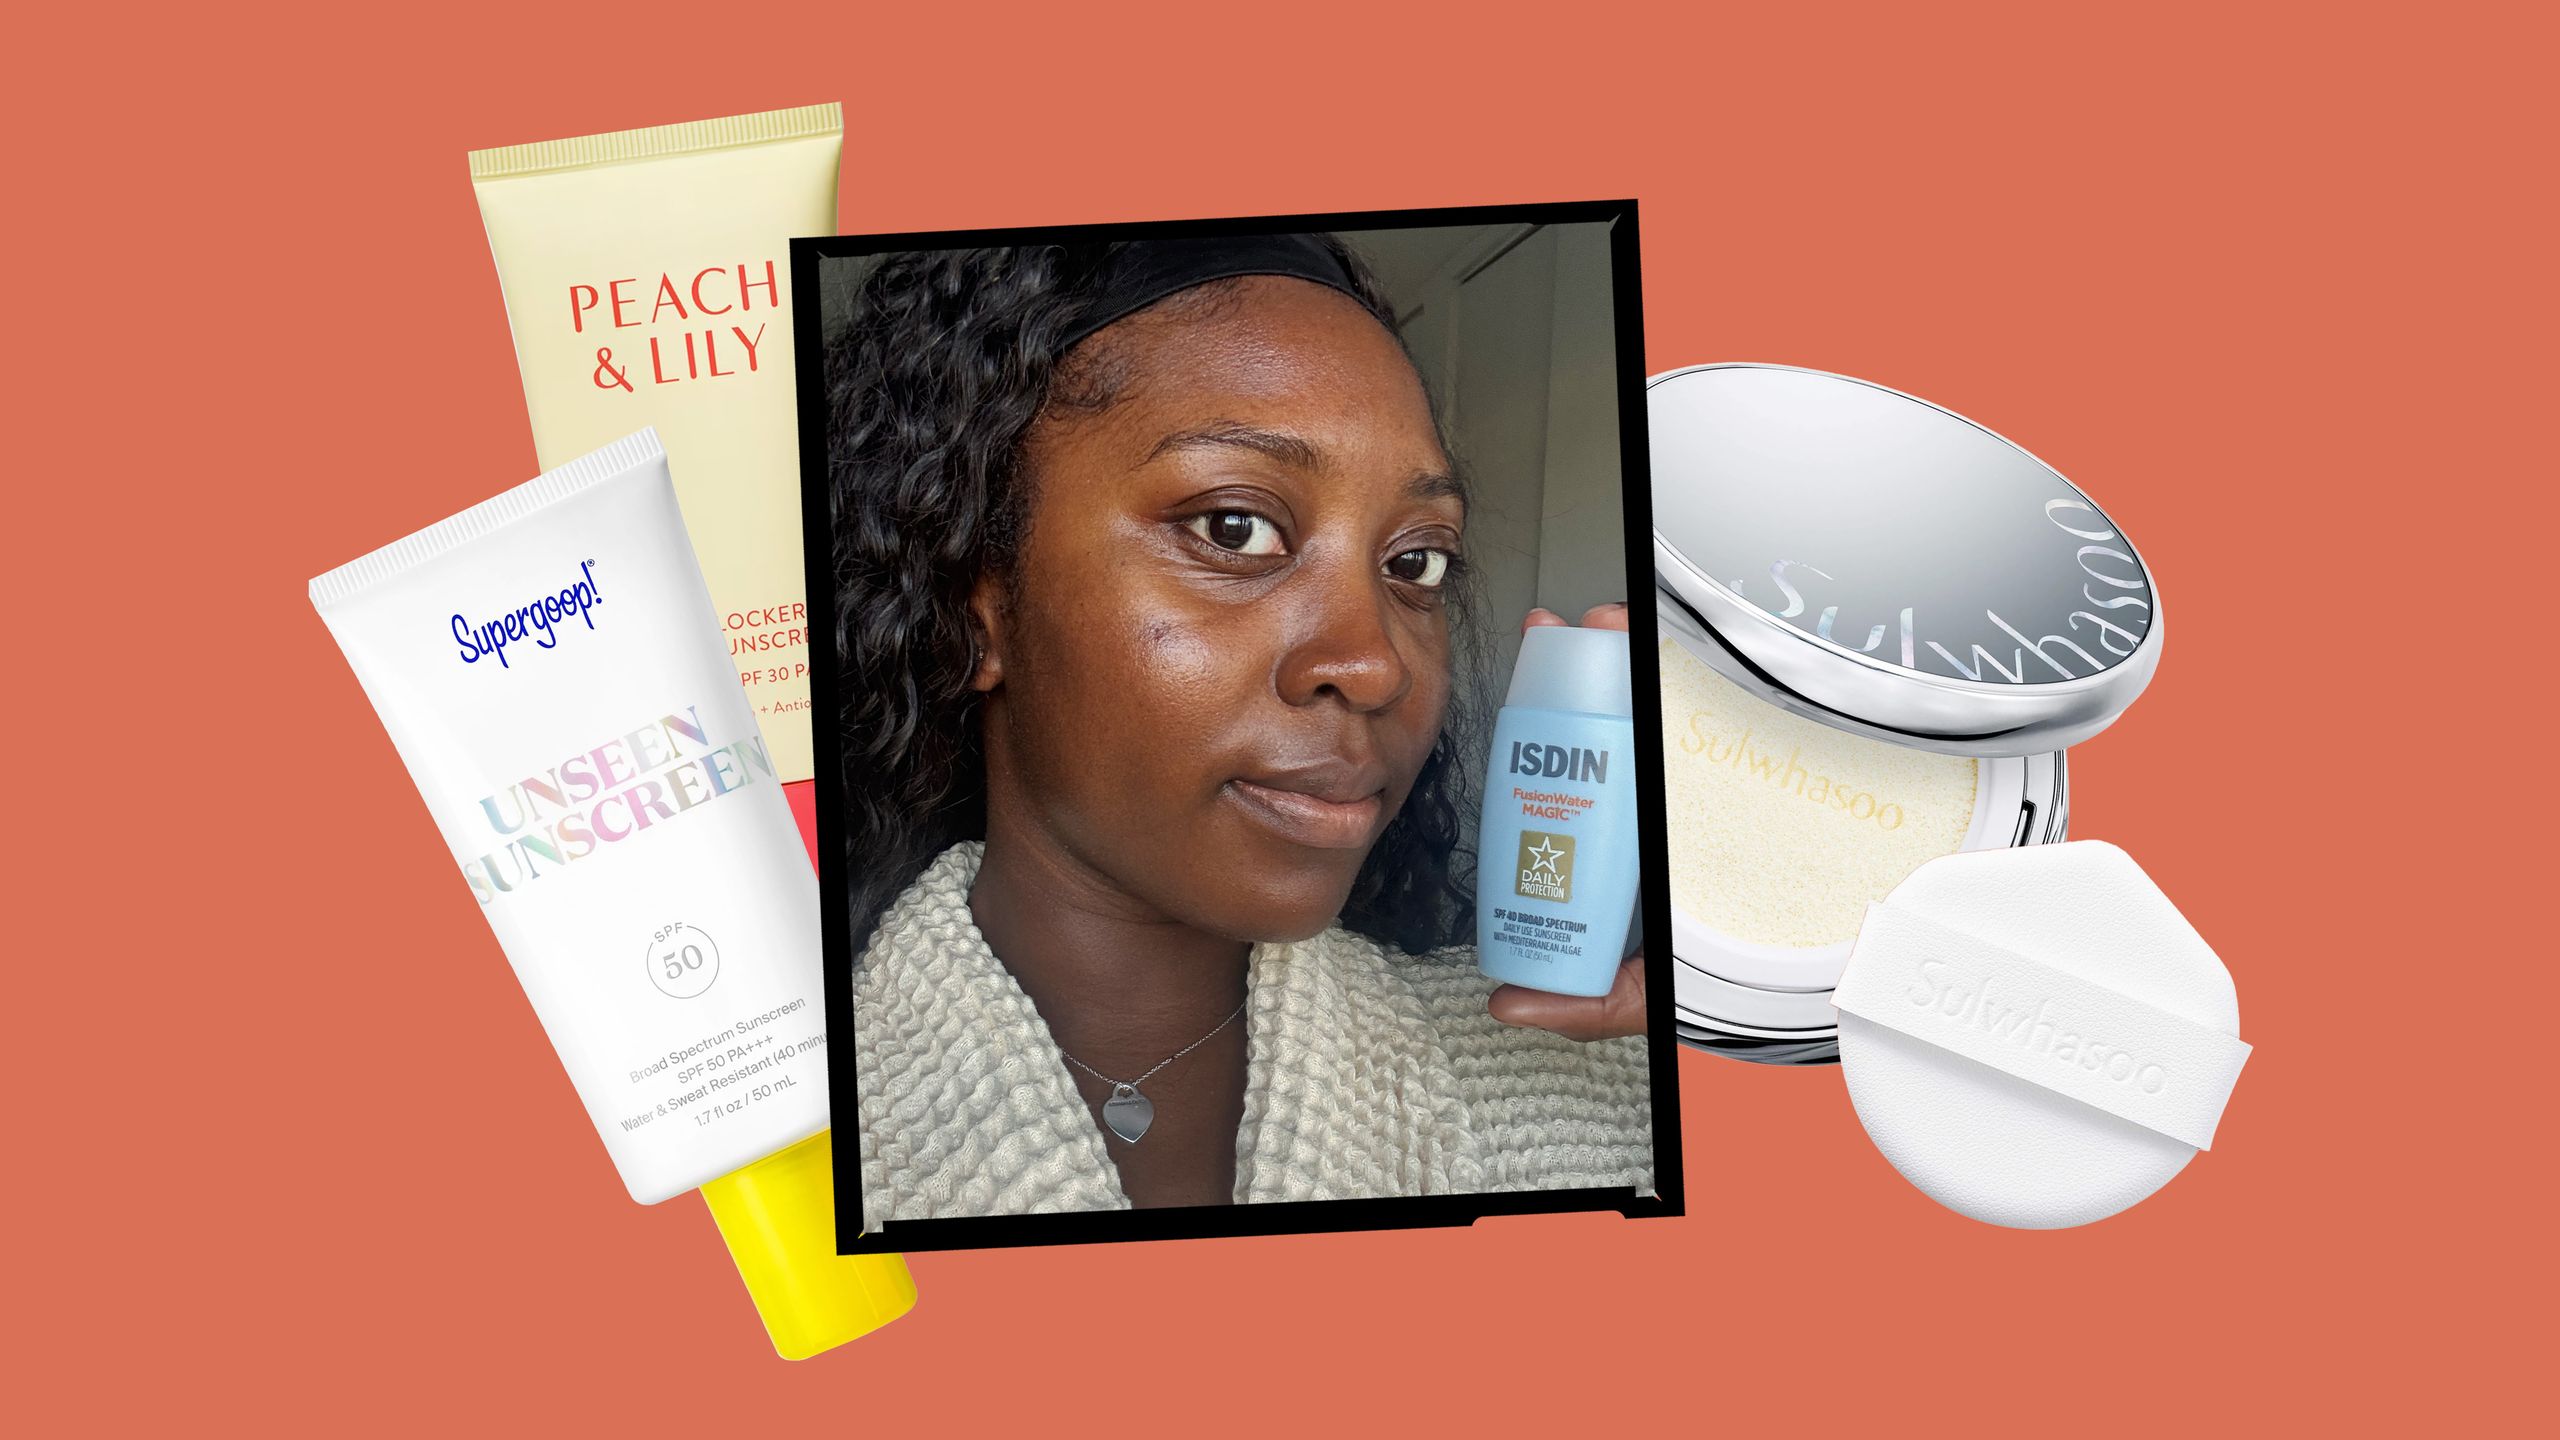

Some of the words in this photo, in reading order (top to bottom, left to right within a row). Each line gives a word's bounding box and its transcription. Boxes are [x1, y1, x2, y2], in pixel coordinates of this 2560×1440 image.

[569, 260, 779, 333] PEACH
[593, 346, 634, 393] &
[649, 322, 766, 384] LILY
[1729, 498, 2149, 684] Sulwhasoo
[721, 602, 806, 631] OCKER
[767, 666, 789, 683] 30
[479, 705, 709, 835] UNSEEN
[1509, 741, 1609, 784] ISDIN
[1679, 710, 1905, 832] Sulwhasoo
[463, 735, 772, 906] SUNSCREEN
[1513, 787, 1595, 809] FusionWater
[1520, 881, 1565, 899] PROTECTION
[1522, 869, 1566, 887] DAILY
[654, 921, 683, 943] SPF
[1493, 908, 1507, 919] SPF
[1517, 912, 1545, 927] BROAD
[1545, 917, 1588, 934] SPECTRUM
[1493, 931, 1508, 942] WITH
[1508, 934, 1560, 953] MEDITERRANEAN
[1560, 944, 1583, 957] ALGAE
[1503, 921, 1521, 934] DAILY
[1521, 926, 1533, 937] USE
[1534, 927, 1572, 943] SUNSCREEN
[663, 944, 703, 980] 50
[629, 1057, 669, 1084] Broad
[669, 1028, 735, 1064] Spectrum
[735, 998, 806, 1034] Sunscreen
[1904, 958, 2168, 1095] Sulwhasoo
[677, 1062, 704, 1084] SPF
[706, 1054, 726, 1071] 50
[727, 1035, 773, 1063] PA+++
[620, 1110, 655, 1132] Water
[656, 1104, 669, 1117] &
[668, 1085, 709, 1111] Sweat
[709, 1056, 772, 1093] Resistant
[773, 1044, 796, 1066] (40
[694, 1109, 711, 1127] 1.7
[713, 1105, 724, 1119] fl
[726, 1099, 743, 1114] oz
[752, 1084, 772, 1102] 50
[773, 1074, 797, 1093] mL
